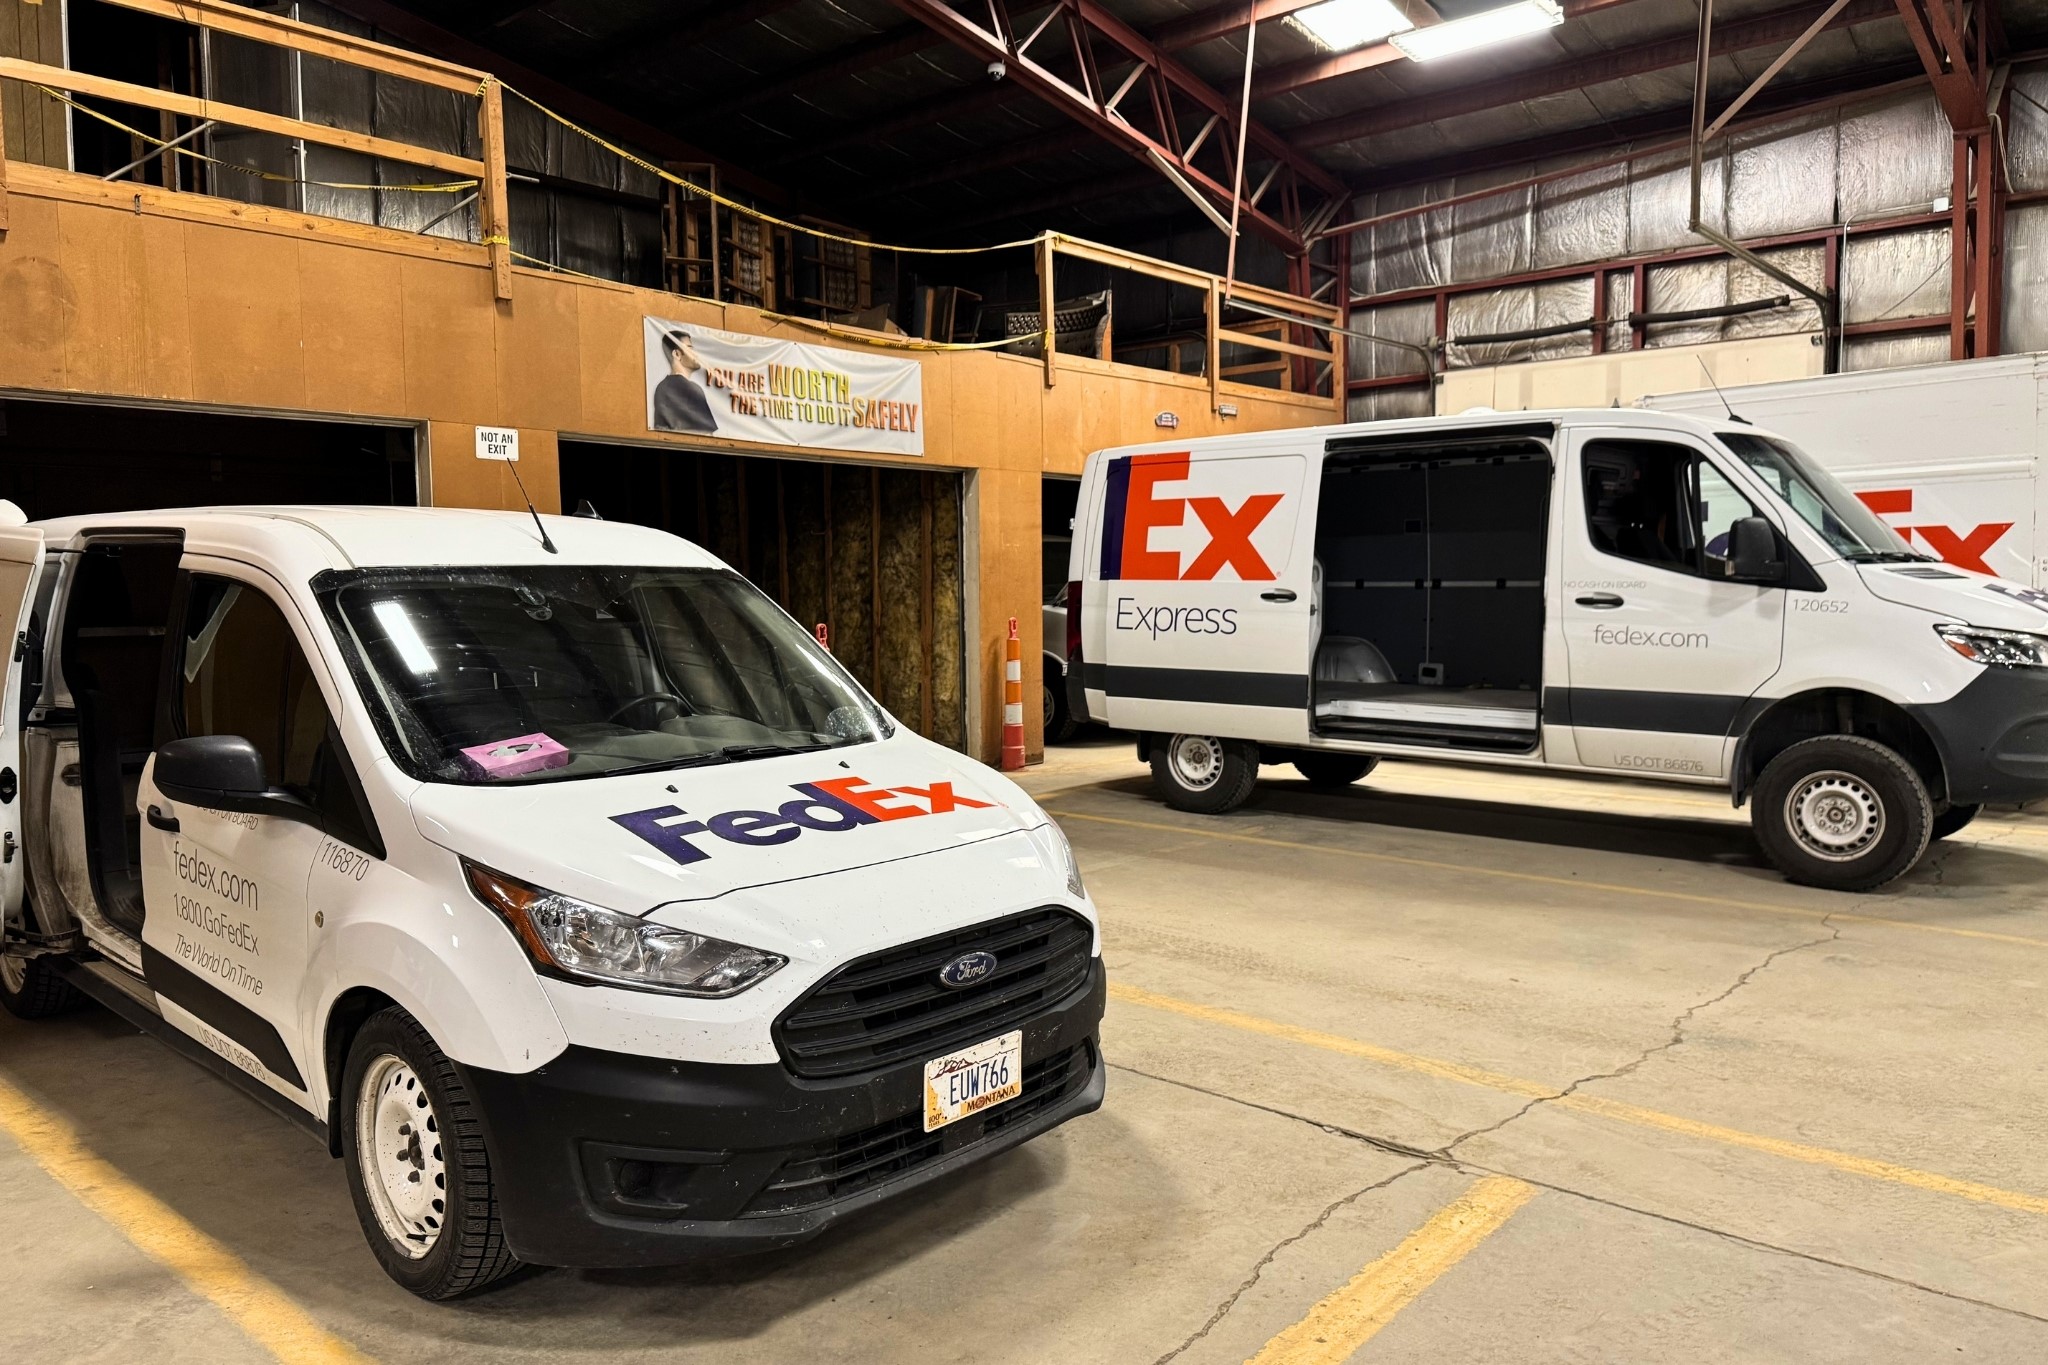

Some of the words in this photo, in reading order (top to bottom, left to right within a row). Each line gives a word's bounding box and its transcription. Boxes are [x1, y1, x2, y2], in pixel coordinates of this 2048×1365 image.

[705, 367, 735, 389] YOU
[738, 371, 765, 394] ARE
[768, 363, 850, 404] WORTH
[730, 393, 757, 416] THE
[760, 397, 793, 420] TIME
[796, 401, 812, 422] TO
[817, 405, 835, 424] DO
[838, 407, 851, 426] IT
[852, 396, 919, 433] SAFELY
[480, 431, 499, 443] NOT
[501, 433, 513, 444] AN
[488, 444, 507, 455] EXIT
[1116, 597, 1238, 641] Express
[1792, 598, 1849, 614] 120652
[1593, 624, 1709, 649] fedex.com
[1614, 753, 1631, 766] US
[1633, 756, 1661, 768] DOT
[1663, 758, 1704, 772] 86876
[232, 812, 259, 830] BOARD
[607, 776, 999, 865] FedEx
[173, 841, 258, 911] fedex.com
[321, 842, 371, 881] 116870
[173, 892, 260, 957] 1.800.GoFedEx
[175, 933, 192, 958] The
[192, 942, 221, 973] World
[221, 957, 237, 982] On
[237, 964, 263, 996] Time
[956, 958, 986, 981] Ford
[196, 1025, 214, 1047] US
[212, 1033, 235, 1060] DOT
[950, 1056, 1009, 1106] EUW766
[966, 1085, 1015, 1112] MONTANA
